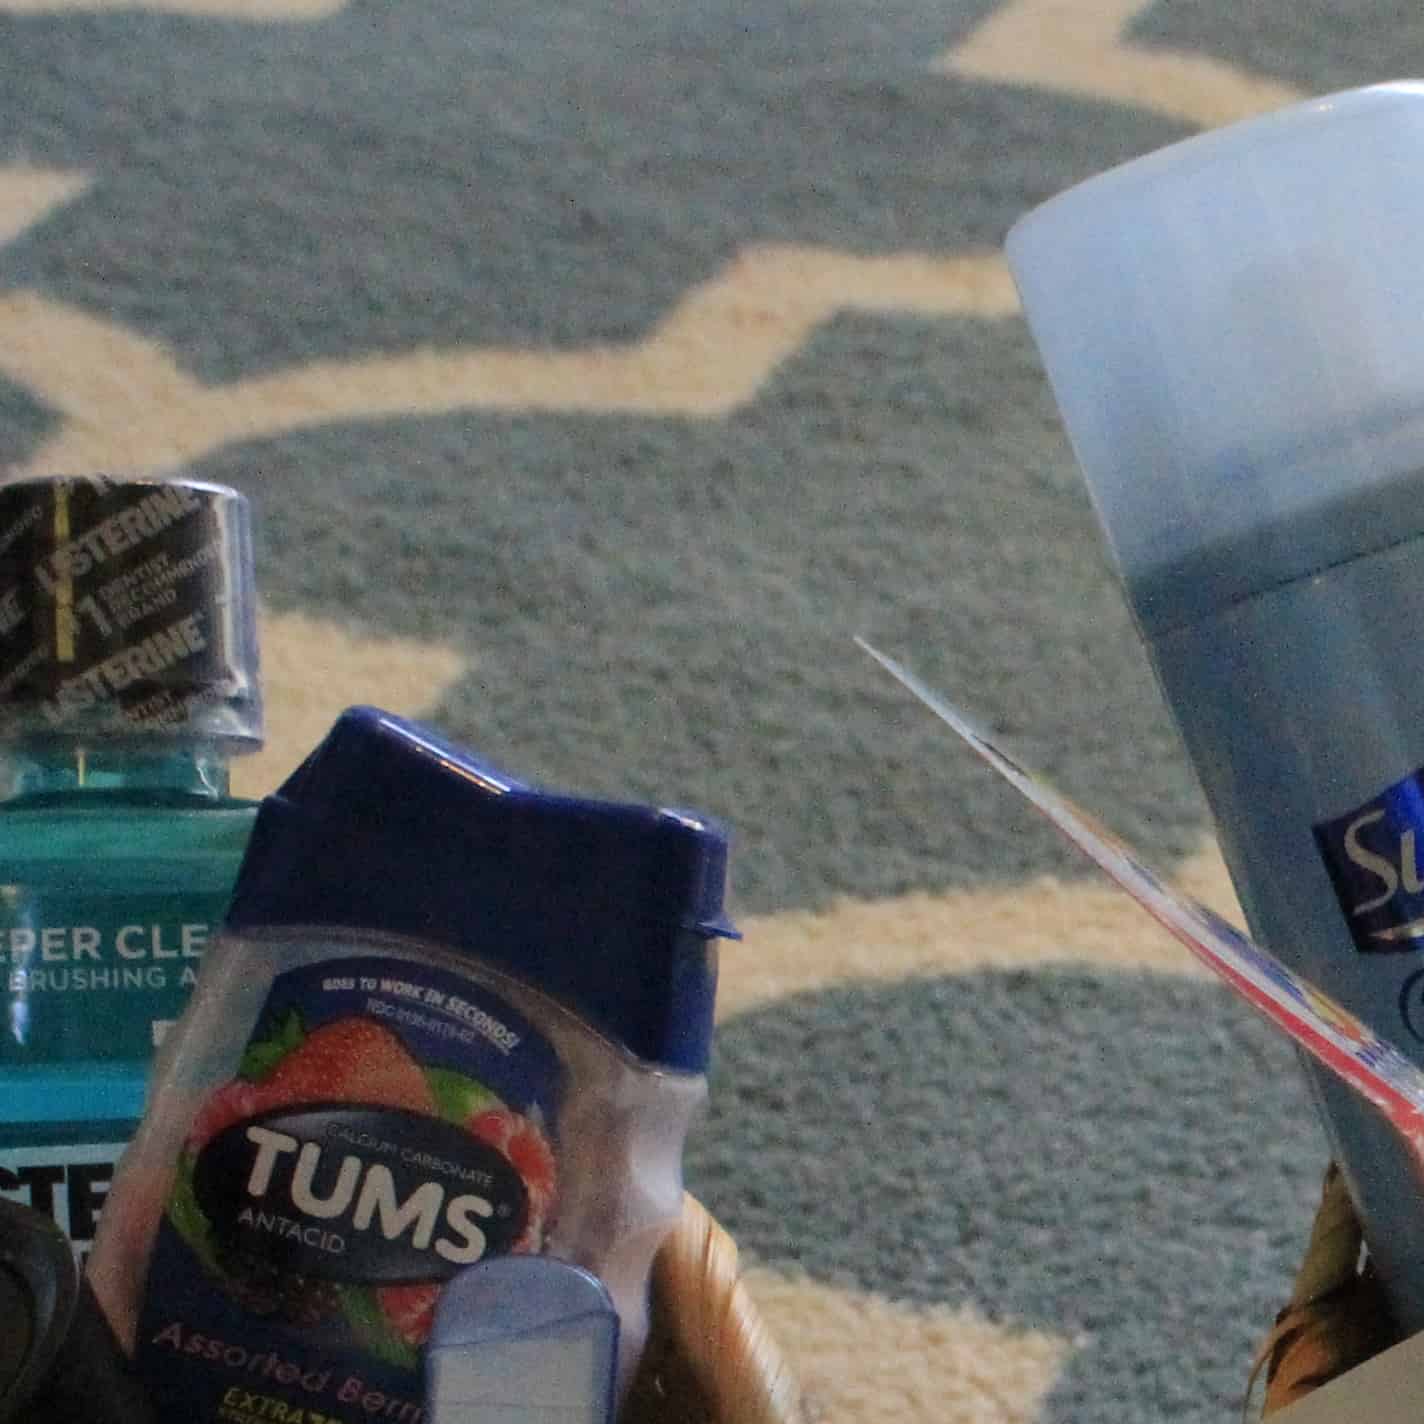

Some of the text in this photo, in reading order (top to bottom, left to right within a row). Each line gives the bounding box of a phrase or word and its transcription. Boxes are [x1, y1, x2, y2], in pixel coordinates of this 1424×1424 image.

[0, 924, 209, 960] PER CLE
[9, 965, 199, 993] BRUSHING A
[245, 1125, 494, 1266] TUMS
[236, 1206, 346, 1254] ANTACID
[152, 1321, 329, 1394] Assorted
